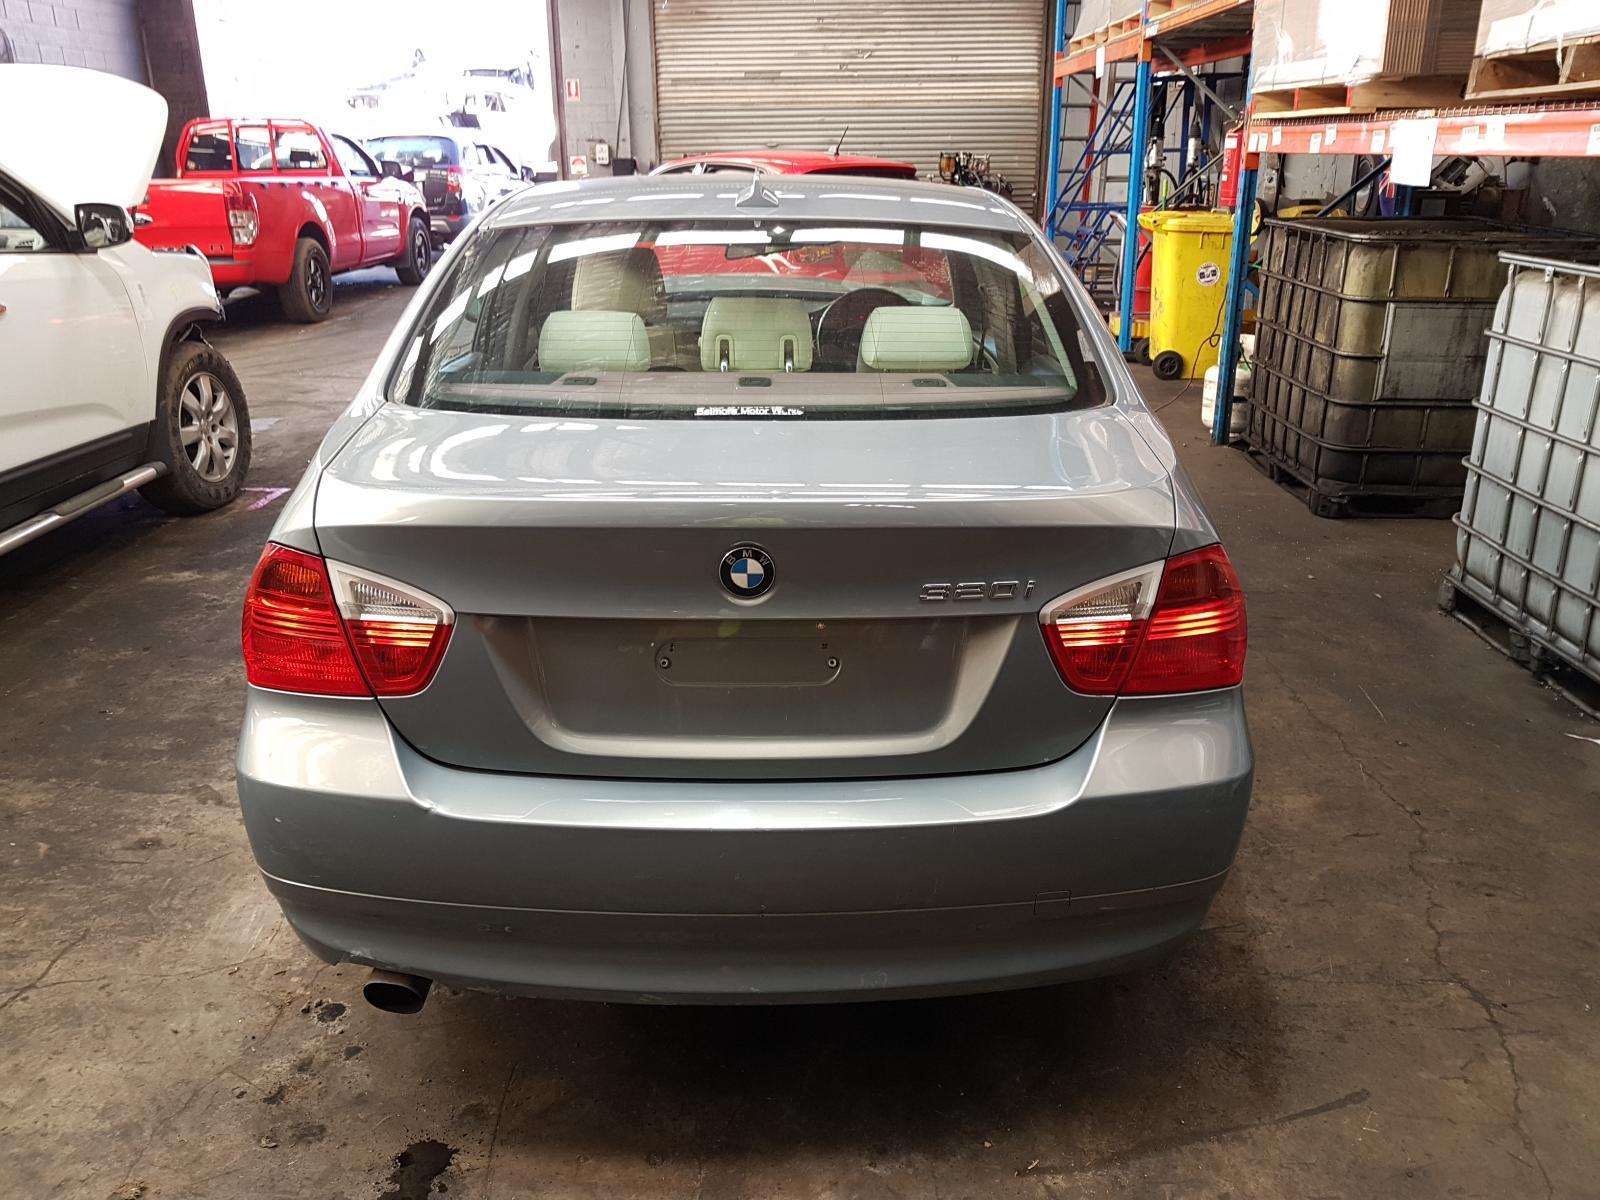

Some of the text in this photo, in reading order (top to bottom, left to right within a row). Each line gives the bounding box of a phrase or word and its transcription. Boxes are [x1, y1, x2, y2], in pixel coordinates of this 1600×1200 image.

[740, 406, 770, 416] Motor
[725, 549, 770, 566] BMW
[919, 580, 1037, 600] 320i
